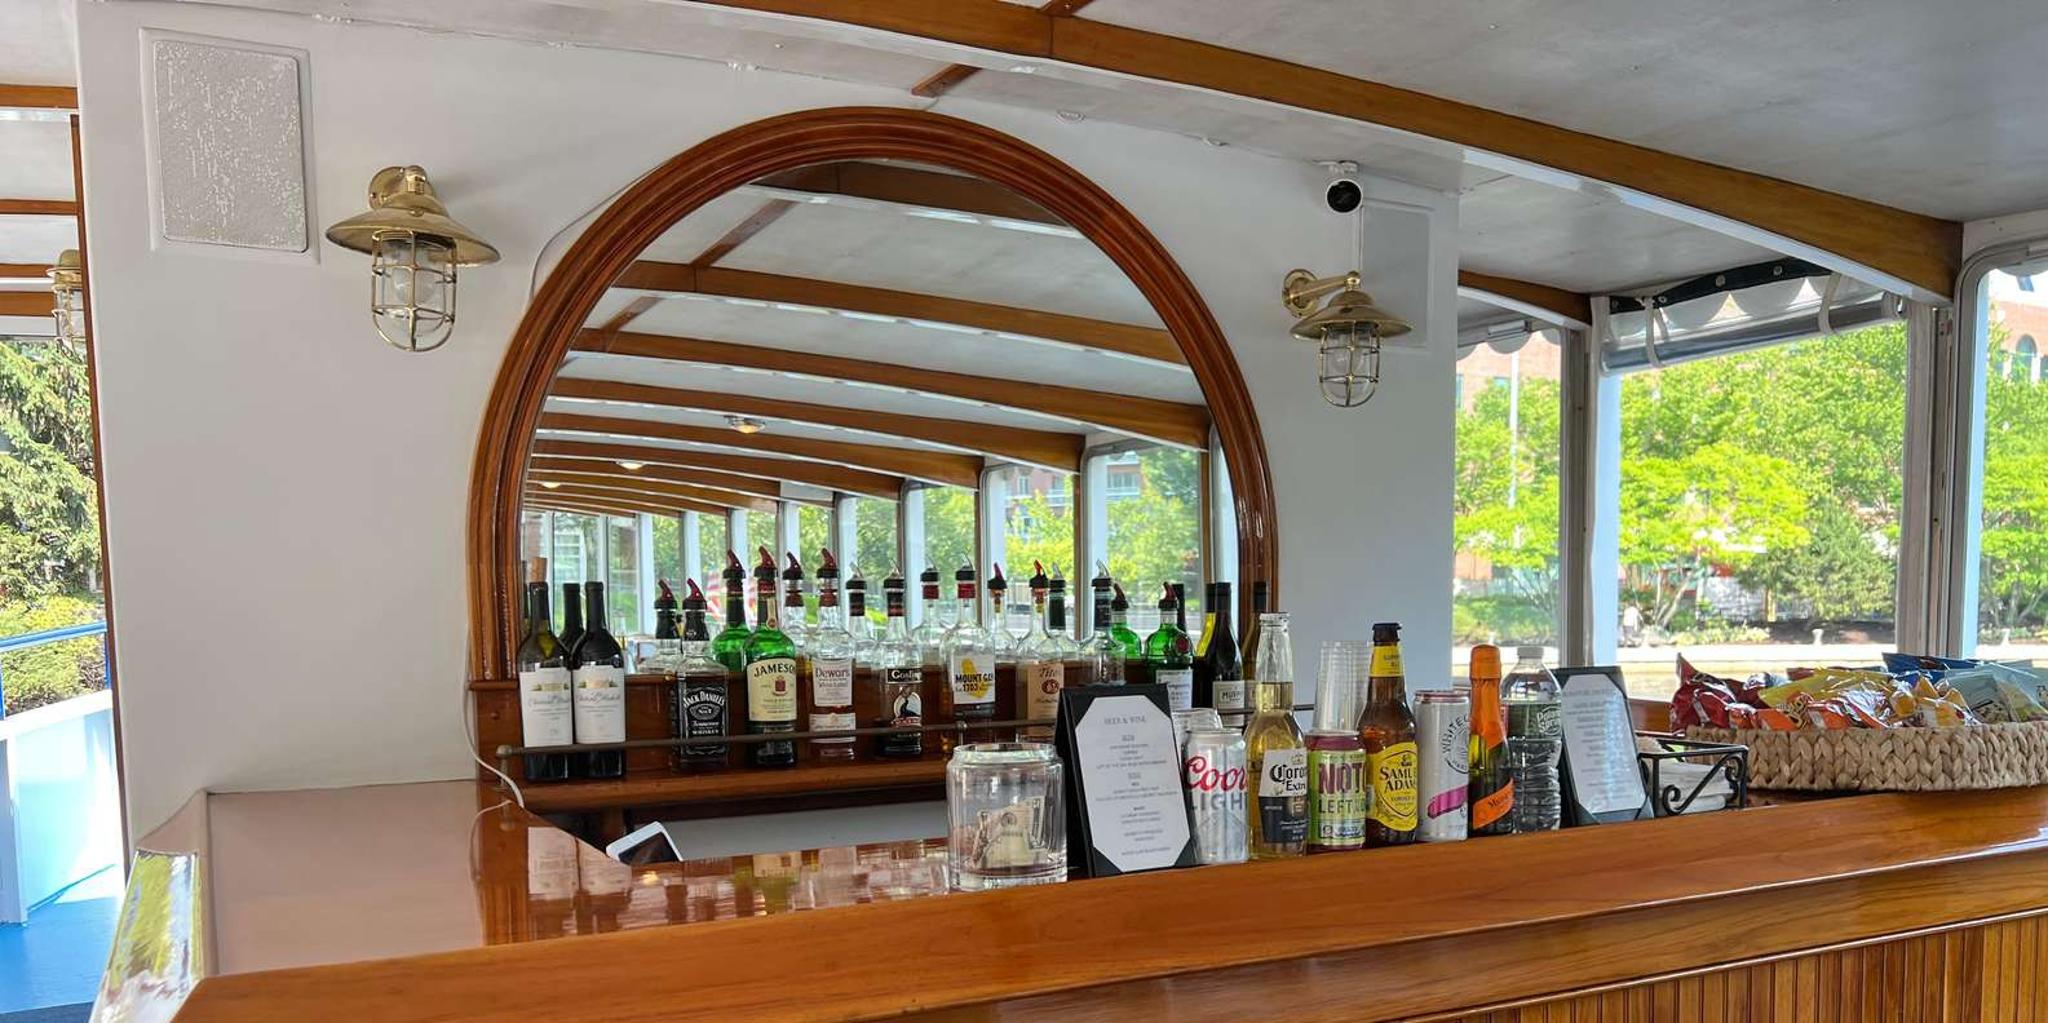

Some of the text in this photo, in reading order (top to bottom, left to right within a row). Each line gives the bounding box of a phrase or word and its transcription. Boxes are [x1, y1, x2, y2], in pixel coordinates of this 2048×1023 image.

[754, 663, 796, 677] JAMESO
[955, 673, 982, 683] MOUNT
[683, 694, 700, 708] JACK
[1184, 756, 1248, 791] Coor
[1269, 763, 1307, 784] Coro
[1318, 762, 1366, 794] NOT
[1286, 779, 1306, 791] Extr
[1191, 793, 1248, 811] LIGH
[1318, 799, 1353, 814] LEFT
